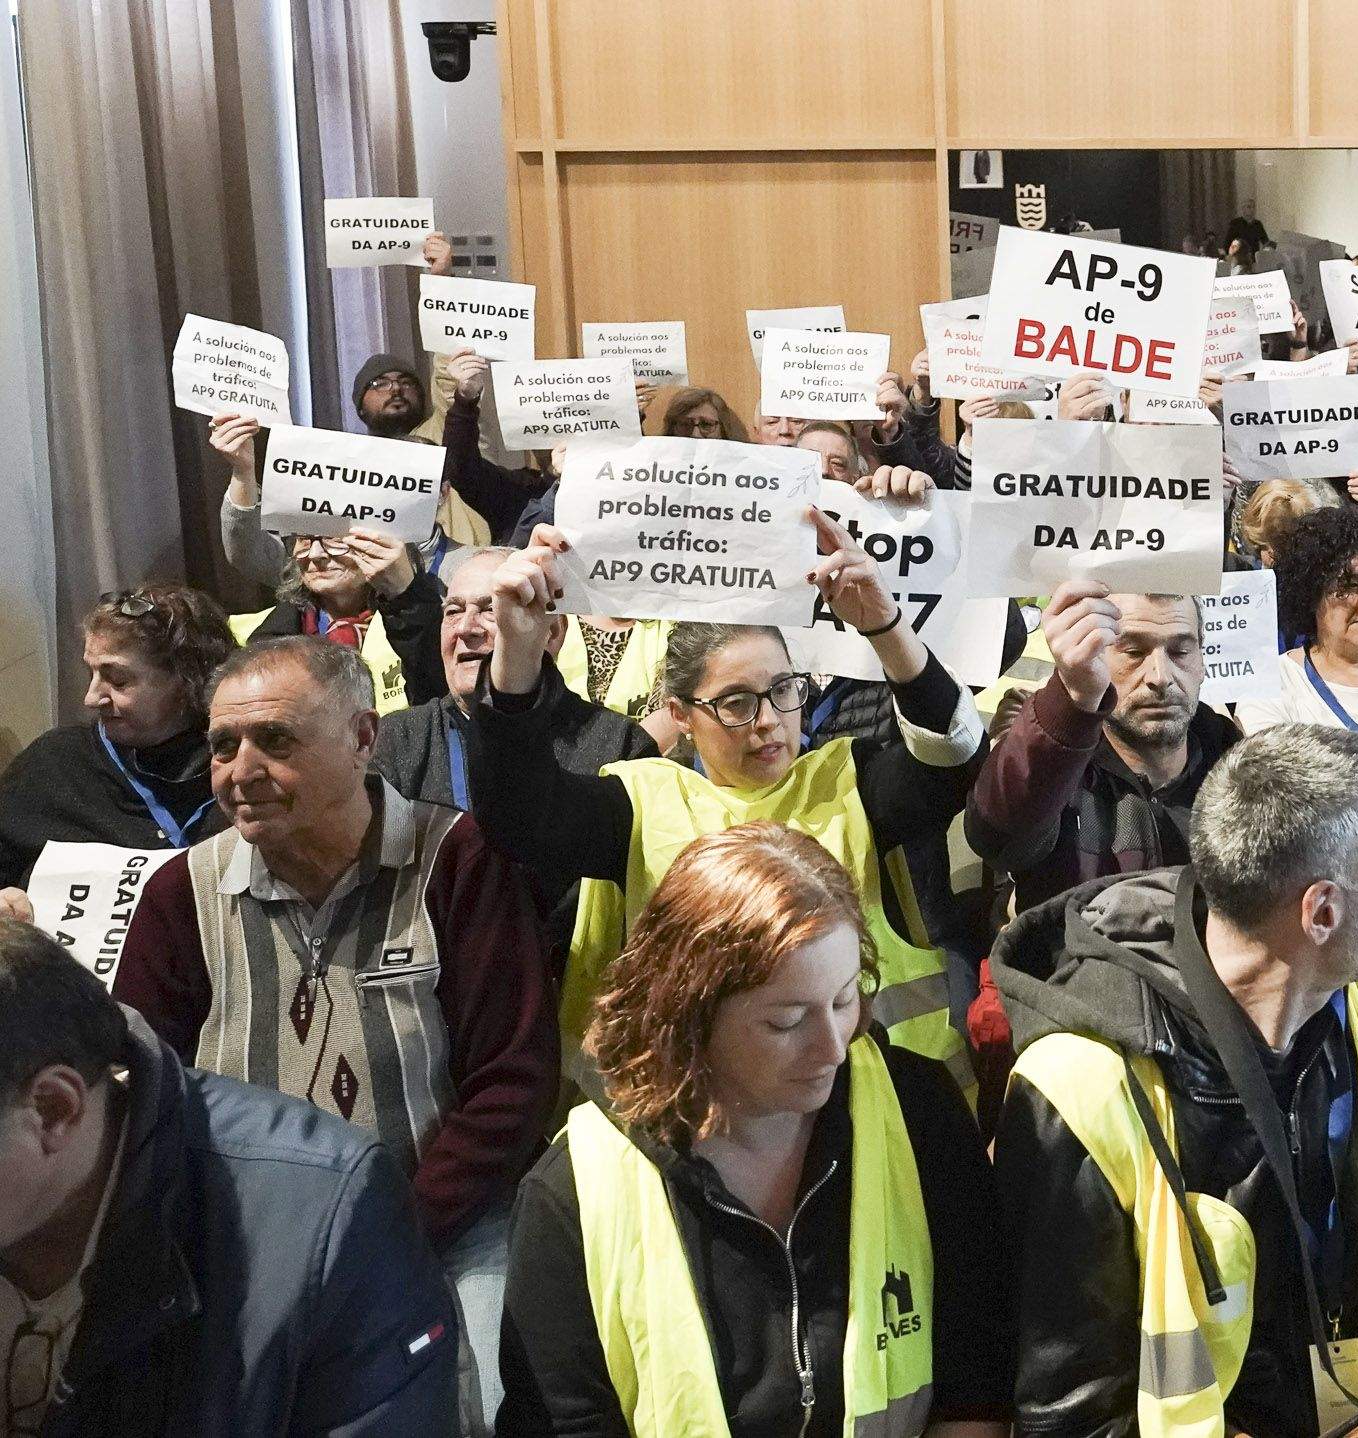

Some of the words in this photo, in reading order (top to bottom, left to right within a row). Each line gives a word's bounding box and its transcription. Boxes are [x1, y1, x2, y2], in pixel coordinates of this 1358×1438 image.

[330, 218, 430, 230] GRATUIDADE
[352, 240, 372, 251] DA
[378, 239, 411, 251] AP-9
[1044, 249, 1163, 302] AP-9
[423, 297, 529, 320] GRATUIDADE
[1084, 302, 1115, 325] de
[1259, 312, 1281, 321] TUITA
[444, 326, 465, 338] DA
[471, 328, 508, 341] AP-9
[944, 328, 953, 338] A
[956, 329, 984, 342] soluc
[1222, 324, 1236, 334] de
[192, 331, 202, 344] A
[205, 332, 256, 354] solución
[258, 346, 277, 363] aos
[601, 346, 652, 356] problemas
[655, 345, 667, 354] de
[781, 342, 791, 353] A
[795, 341, 843, 355] solución
[847, 348, 868, 356] aos
[1014, 318, 1176, 381] BALDE
[193, 352, 256, 374] problemas
[259, 365, 272, 379] de
[783, 360, 846, 371] problemas
[849, 360, 864, 372] de
[1203, 351, 1244, 366] ATUITA
[213, 370, 257, 390] tráfico:
[513, 374, 525, 386] A
[528, 370, 583, 387] solución
[587, 374, 612, 385] aos
[634, 368, 672, 378] RATUITA
[802, 376, 843, 388] tráfico:
[946, 375, 967, 385] AP9
[970, 376, 1027, 390] GRATUITA
[191, 384, 216, 399] AP9
[219, 388, 278, 413] GRATUITA
[518, 391, 590, 405] problemas
[593, 389, 610, 401] de
[780, 389, 804, 401] AP9
[808, 391, 867, 403] GRATUITA
[1146, 399, 1167, 408] AP9
[1170, 400, 1204, 409] GRATU
[542, 406, 591, 420] tráfico:
[523, 422, 549, 435] AP9
[552, 419, 620, 435] GRATUITA
[1259, 441, 1287, 456] DA
[1293, 439, 1339, 455] AP-9
[272, 457, 433, 495] GRATUIDADE
[595, 461, 615, 482] A
[622, 462, 728, 489] solución
[734, 472, 780, 491] aos
[993, 472, 1211, 500] GRATUIDADE
[301, 497, 338, 518] DA
[344, 503, 396, 524] AP-9
[597, 496, 734, 523] problemas
[741, 500, 772, 524] de
[637, 528, 728, 555] tráfico:
[817, 510, 933, 577] top
[1033, 525, 1079, 548] DA
[1090, 527, 1165, 551] AP-9
[589, 558, 644, 584] AP9
[650, 562, 777, 591] GRATUITA
[1221, 594, 1250, 607] aos
[1227, 614, 1247, 630] de
[1205, 660, 1255, 679] ATUITA
[61, 884, 91, 922] DA
[93, 855, 149, 976] GRATUID
